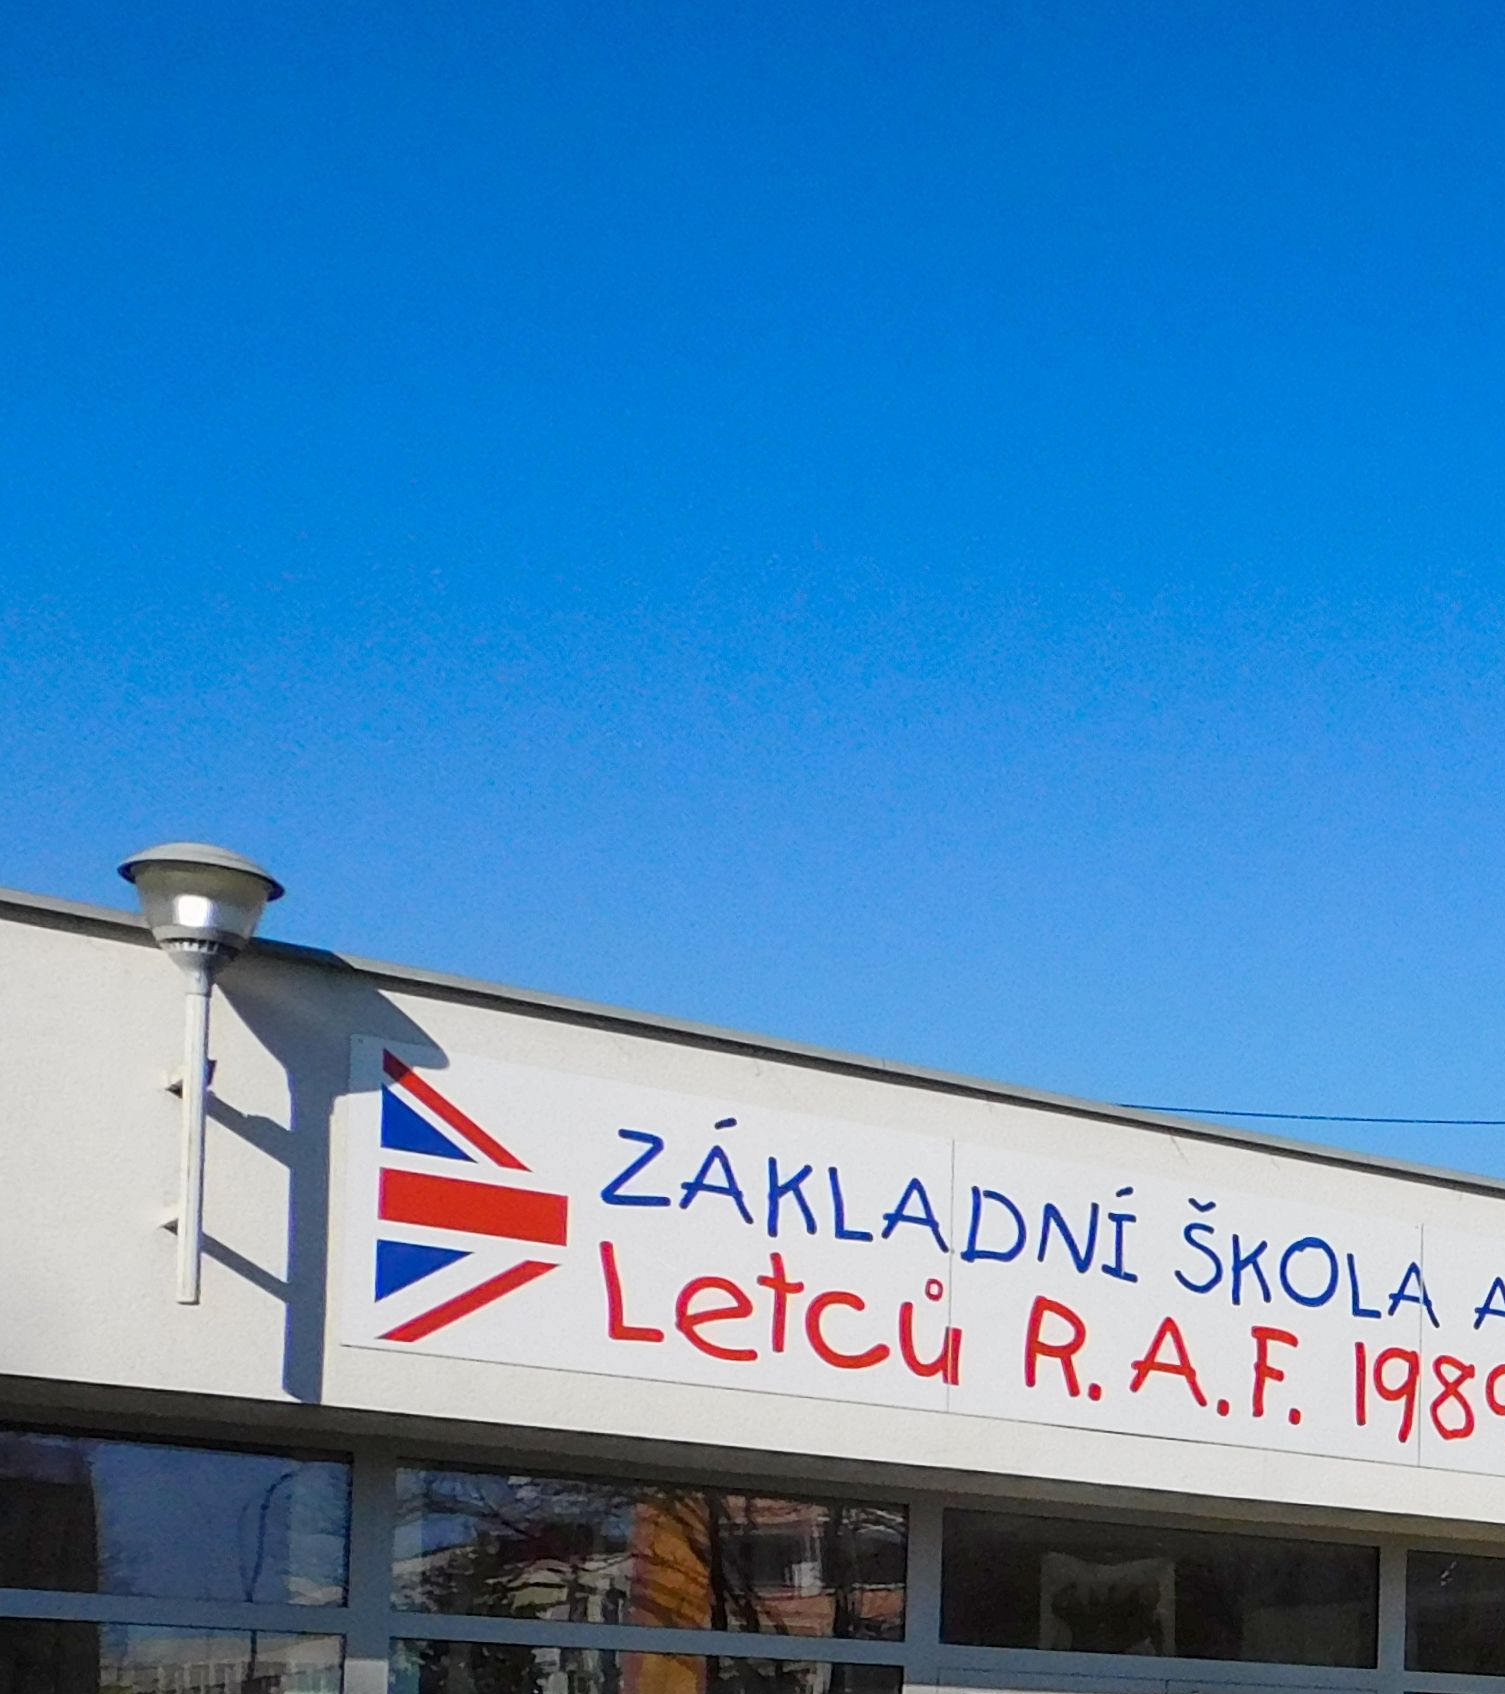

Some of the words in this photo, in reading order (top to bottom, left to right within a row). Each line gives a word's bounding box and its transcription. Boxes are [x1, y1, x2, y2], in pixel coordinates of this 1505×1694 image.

[600, 1117, 1137, 1283] ZÁKLADNÍ
[1175, 1199, 1440, 1329] ŠKOLA
[600, 1240, 963, 1387] Letců
